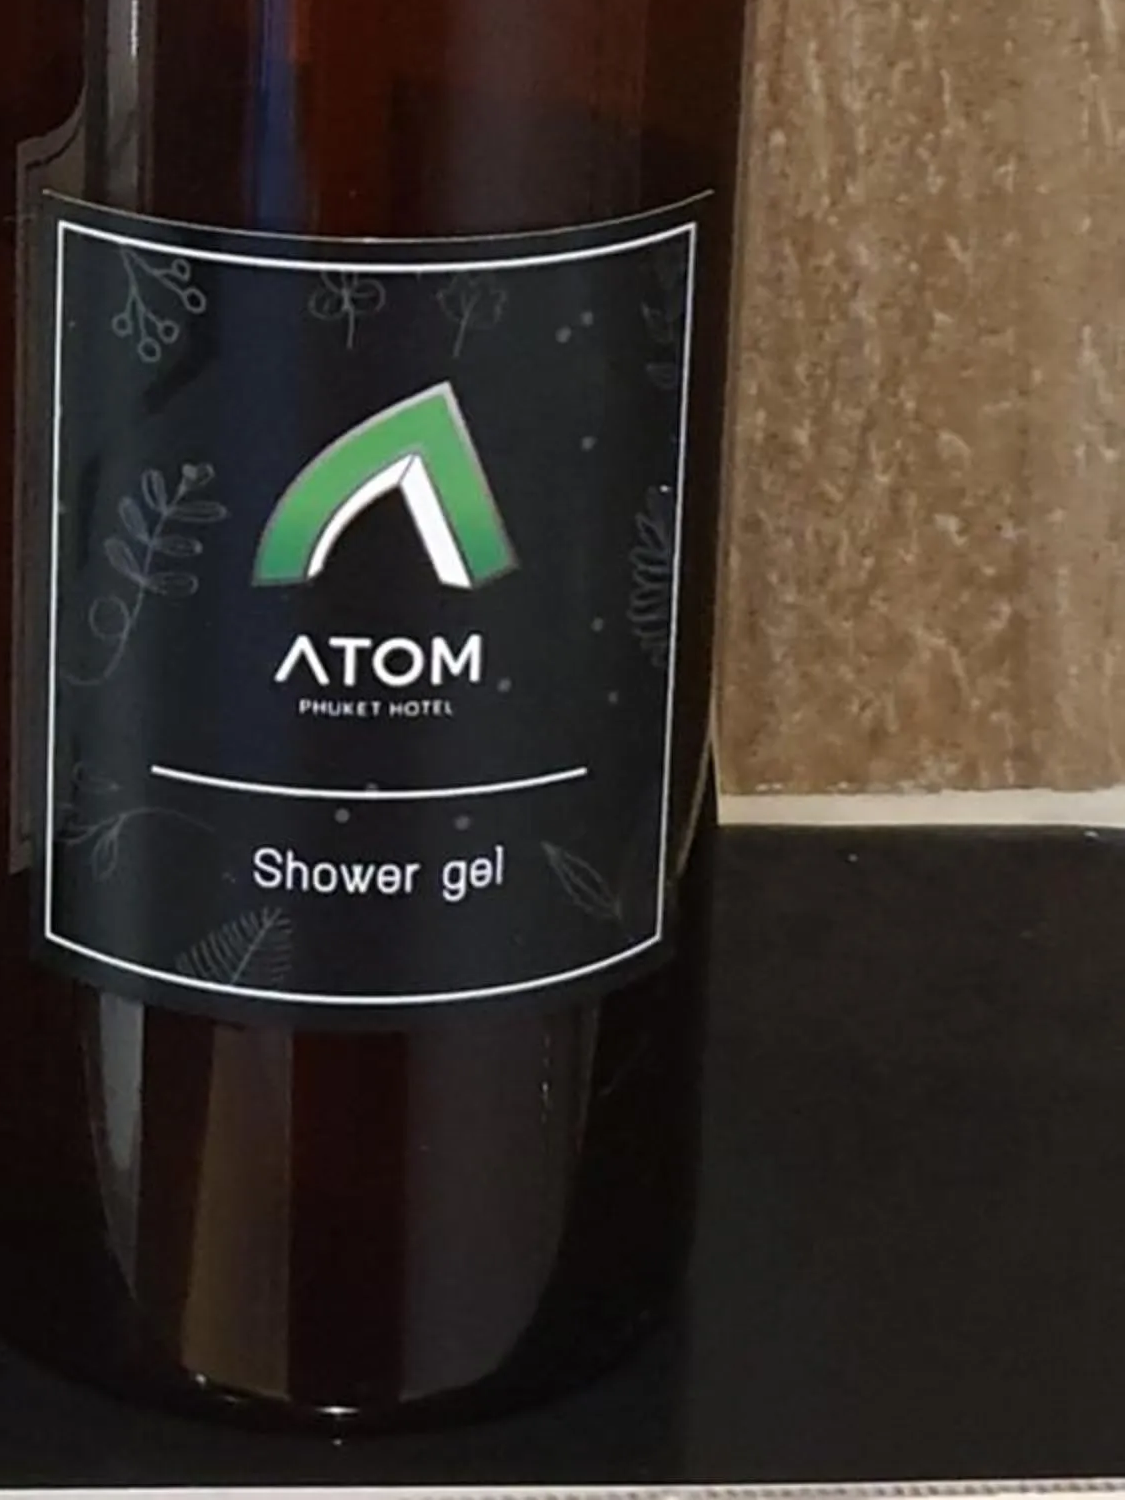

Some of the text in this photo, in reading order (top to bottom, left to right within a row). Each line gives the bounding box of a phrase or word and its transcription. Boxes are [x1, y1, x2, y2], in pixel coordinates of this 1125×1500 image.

[275, 634, 482, 686] ATOM
[298, 700, 453, 716] PHUKET HOTEL
[253, 845, 504, 902] Shower gel
